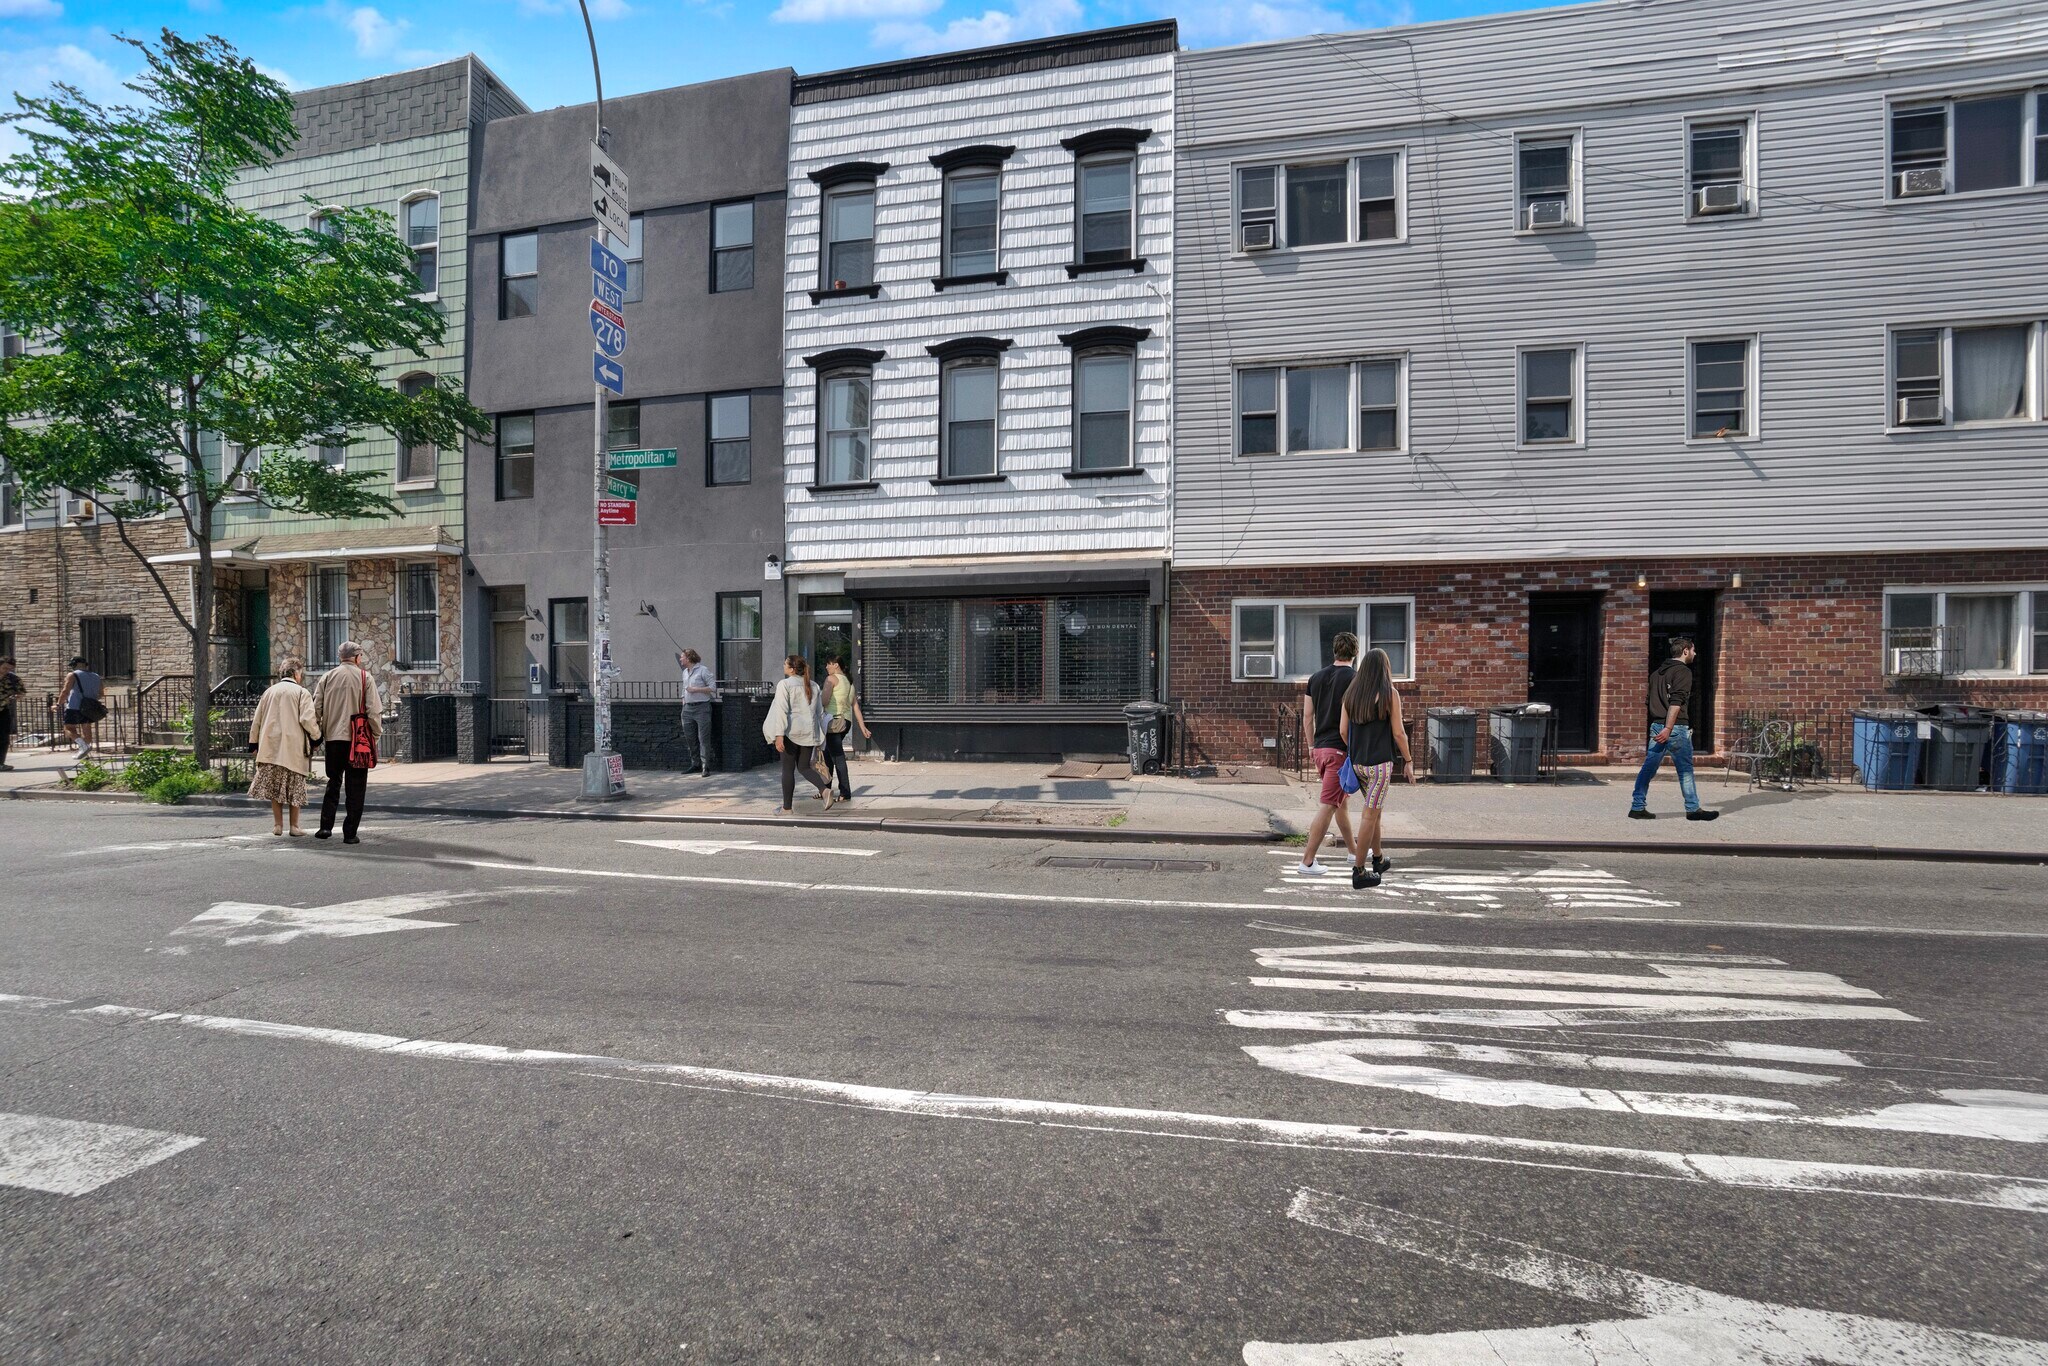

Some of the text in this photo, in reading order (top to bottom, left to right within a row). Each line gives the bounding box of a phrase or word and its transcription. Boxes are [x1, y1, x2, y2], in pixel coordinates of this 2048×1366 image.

[612, 172, 627, 194] TRUCK
[609, 209, 628, 233] LOCAL
[600, 250, 618, 278] TO
[597, 278, 620, 307] WEST
[596, 301, 622, 326] INTERSTATE
[596, 317, 622, 352] 278
[610, 451, 675, 467] Metropolitan Av
[607, 478, 627, 497] Marcy
